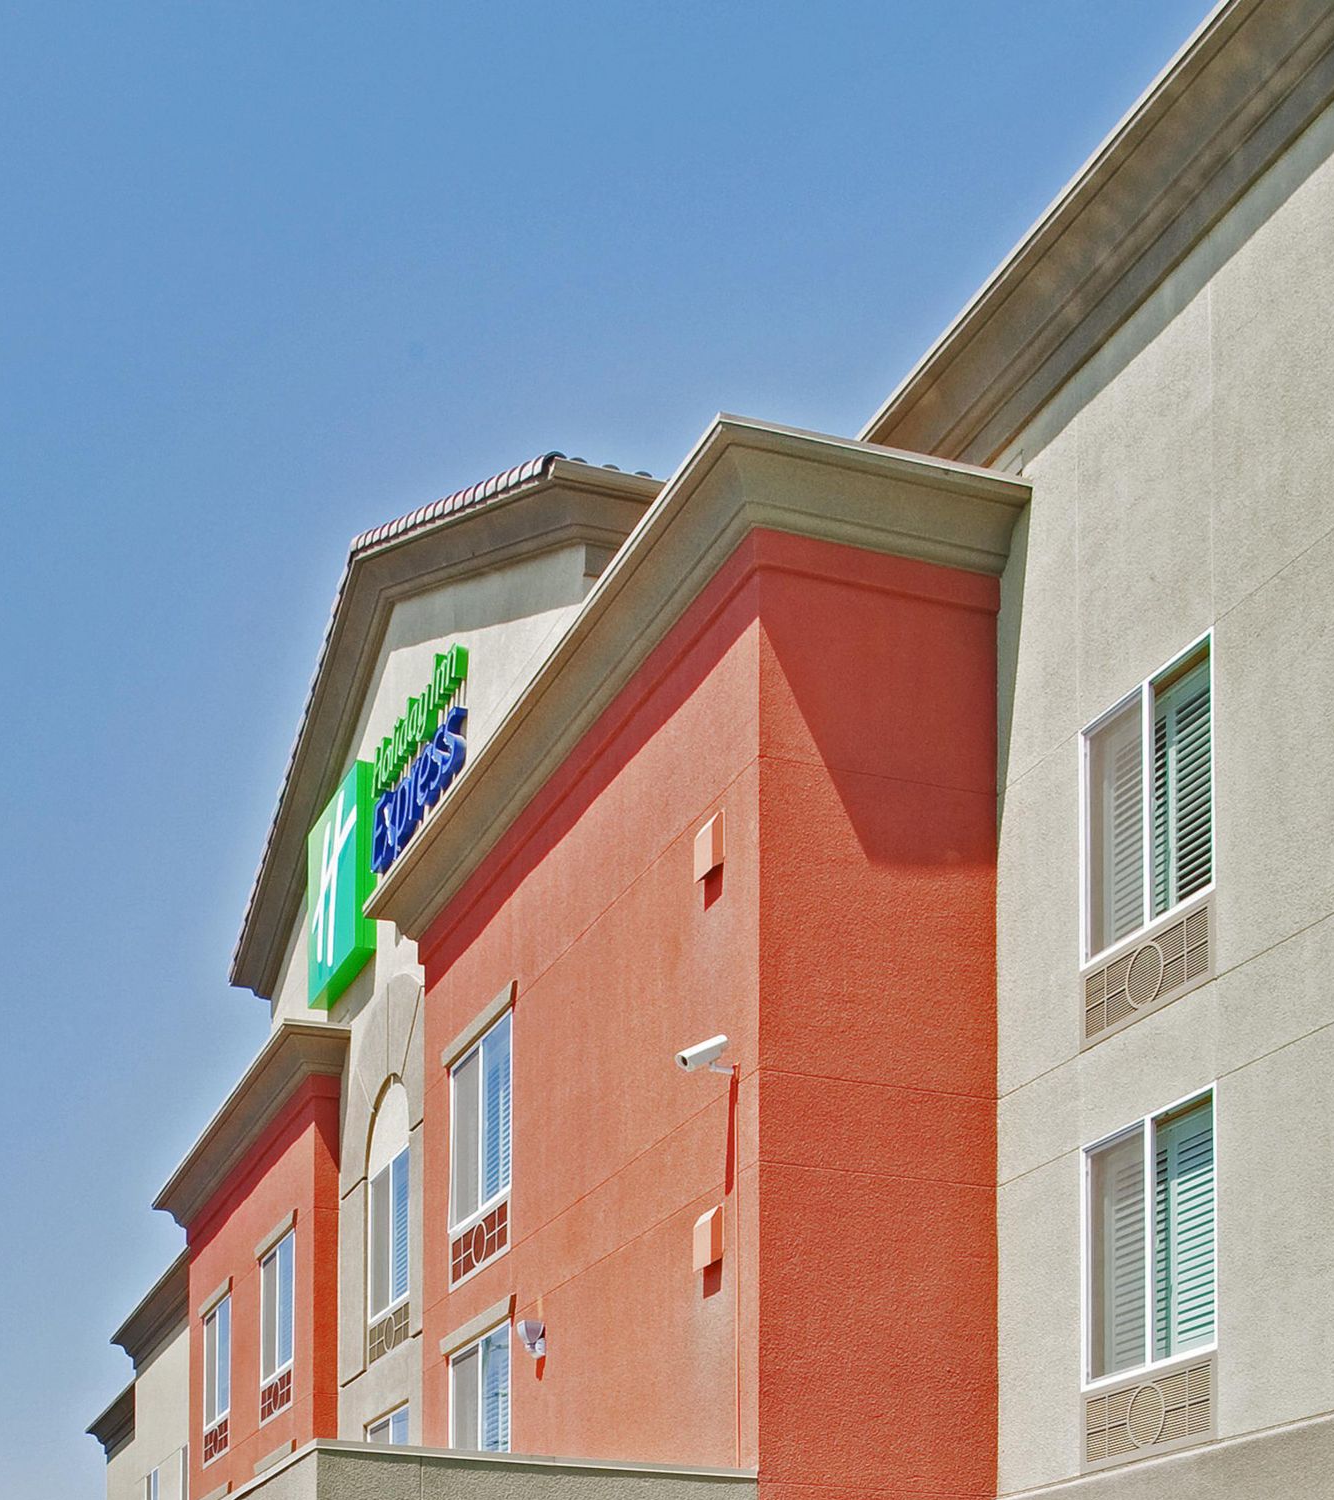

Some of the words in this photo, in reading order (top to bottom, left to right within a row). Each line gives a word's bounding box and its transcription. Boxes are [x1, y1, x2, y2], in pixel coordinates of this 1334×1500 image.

[371, 684, 436, 798] Holiday
[431, 643, 469, 711] Inn
[371, 706, 468, 873] Express
